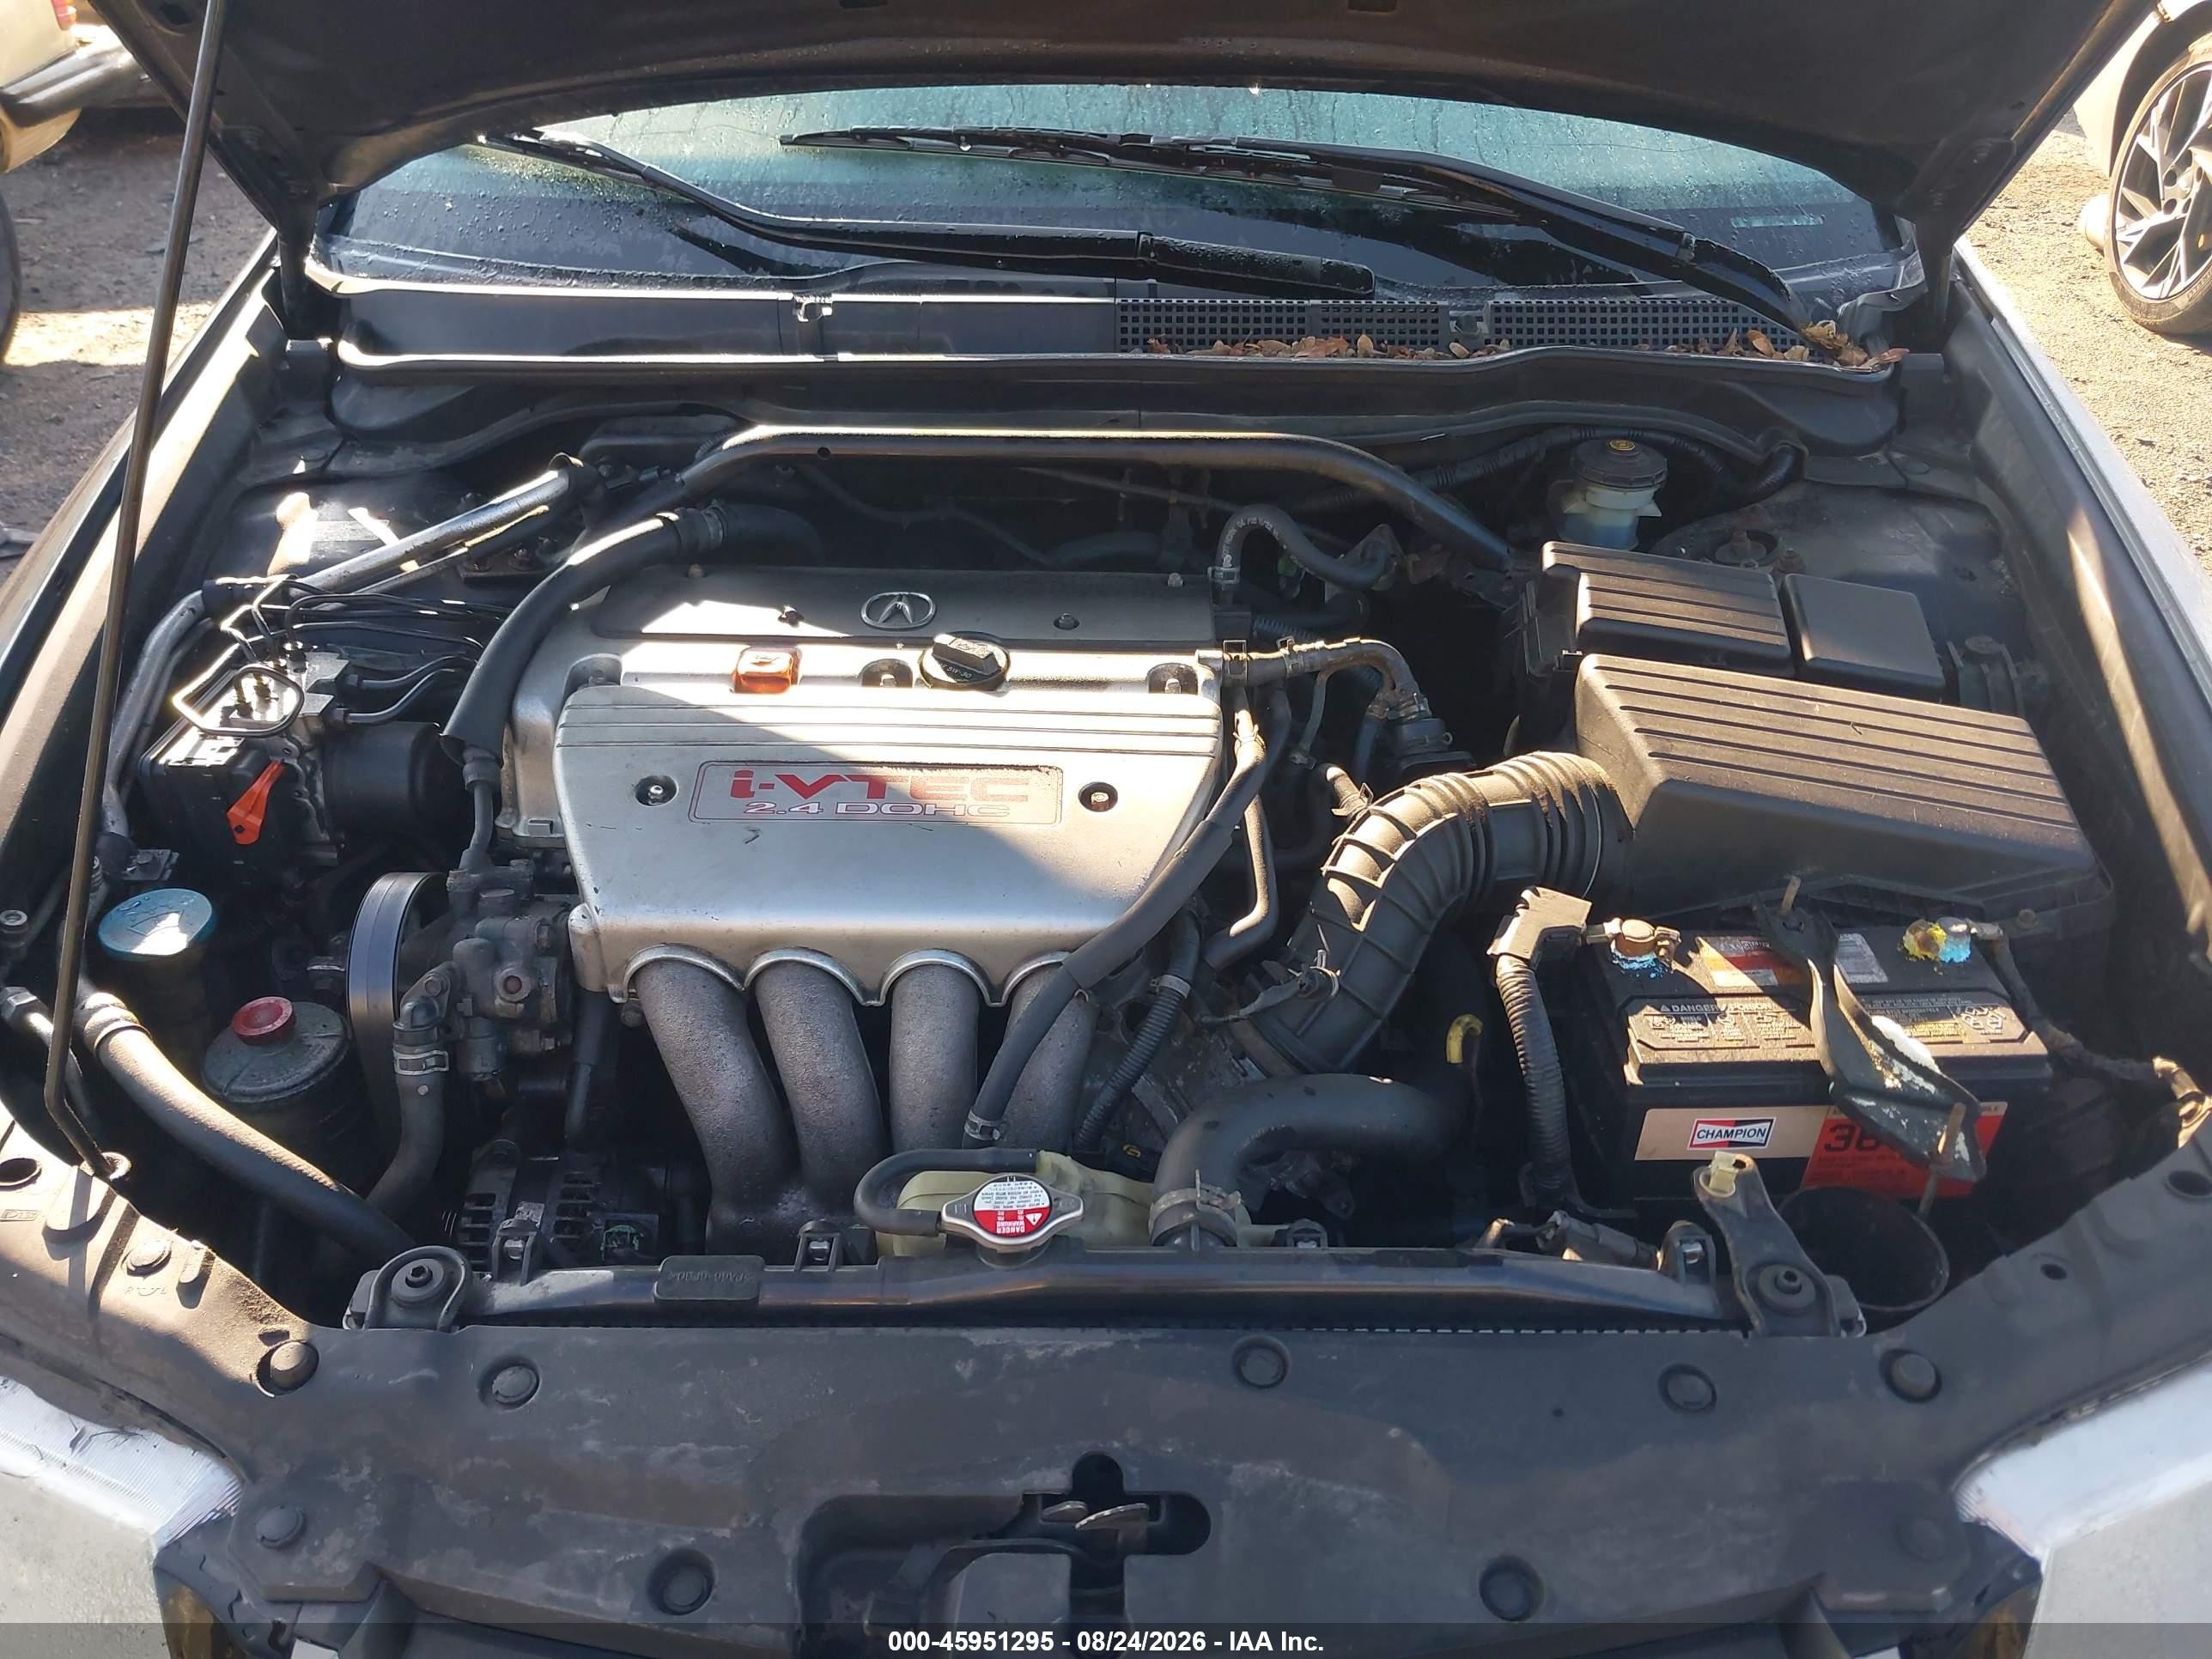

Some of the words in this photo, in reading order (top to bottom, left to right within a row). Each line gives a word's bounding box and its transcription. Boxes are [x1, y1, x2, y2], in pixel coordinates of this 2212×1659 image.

[730, 769, 1029, 803] i-VTEC
[743, 802, 824, 815] 2.4
[835, 802, 1011, 817] DOHC
[1671, 1004, 1719, 1013] DANGER
[1697, 1127, 1766, 1139] CHAMPION
